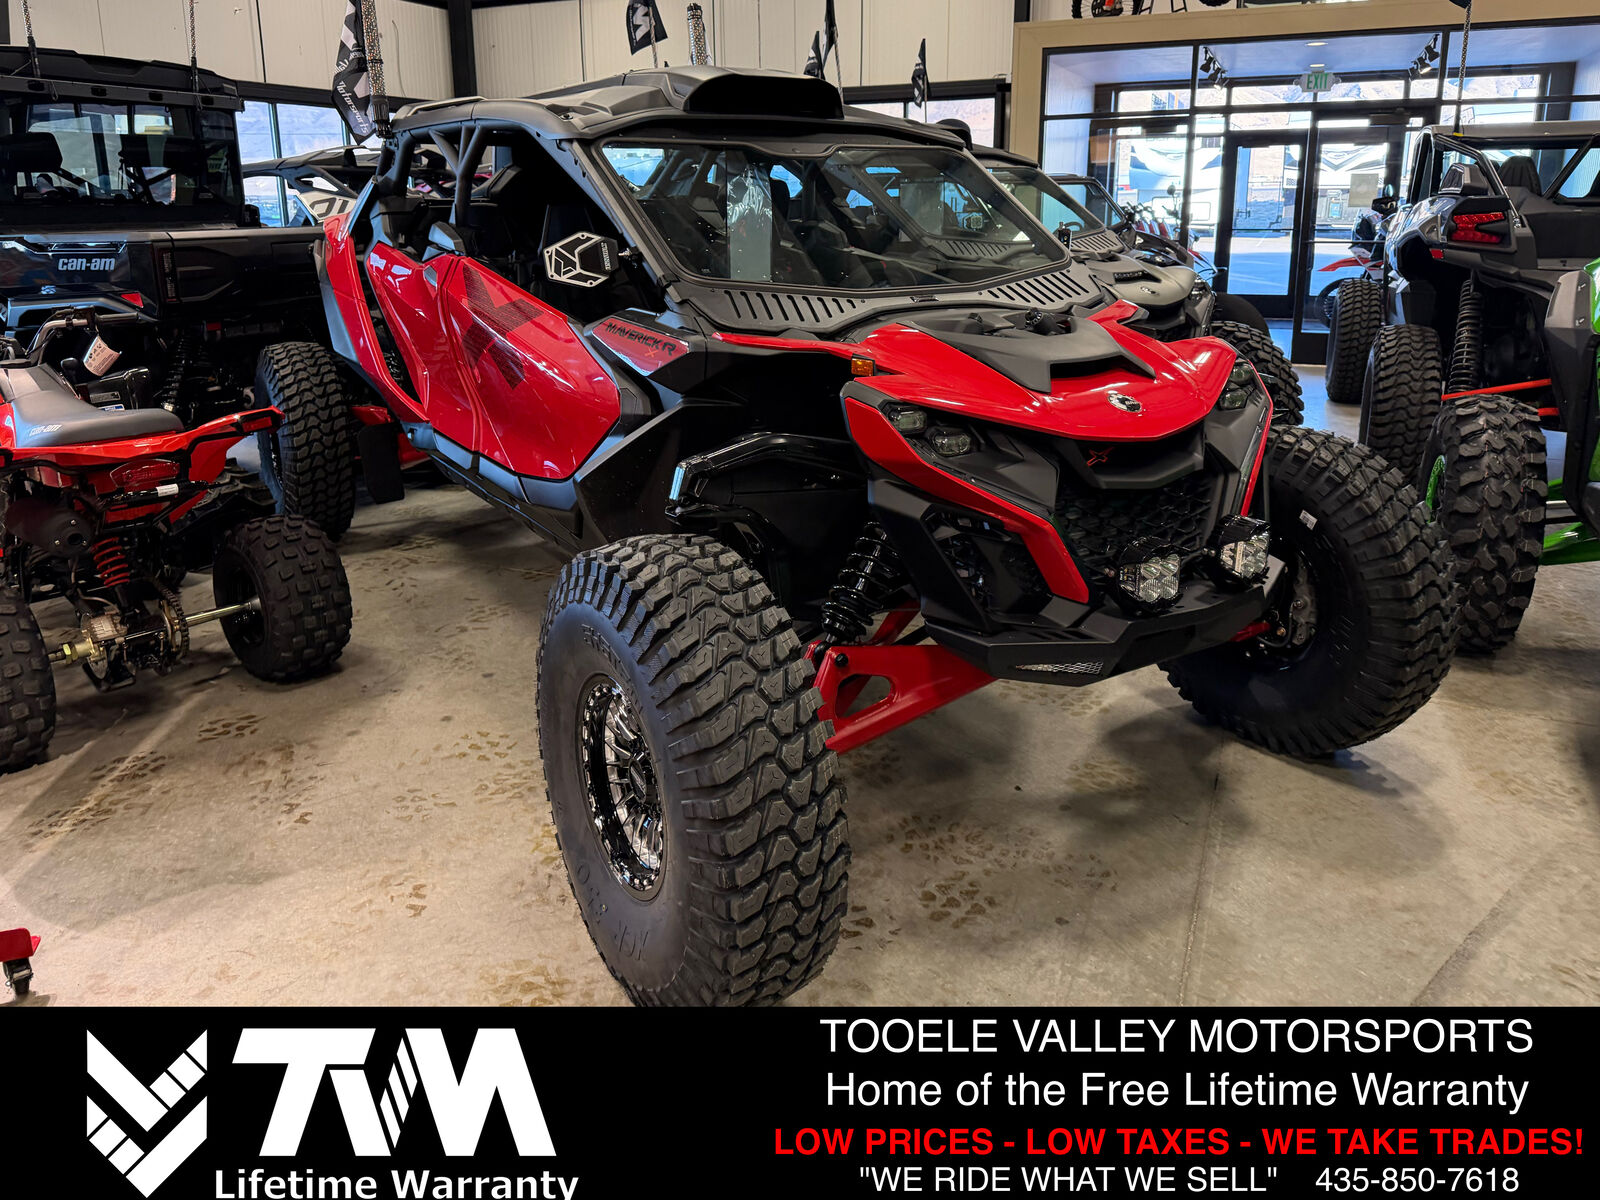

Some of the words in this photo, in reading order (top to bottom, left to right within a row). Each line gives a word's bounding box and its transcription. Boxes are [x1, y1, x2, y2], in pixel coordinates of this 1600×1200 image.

[1307, 72, 1328, 90] EXIT
[58, 257, 116, 271] can-am
[605, 322, 662, 349] MAVERICK
[662, 342, 677, 356] R
